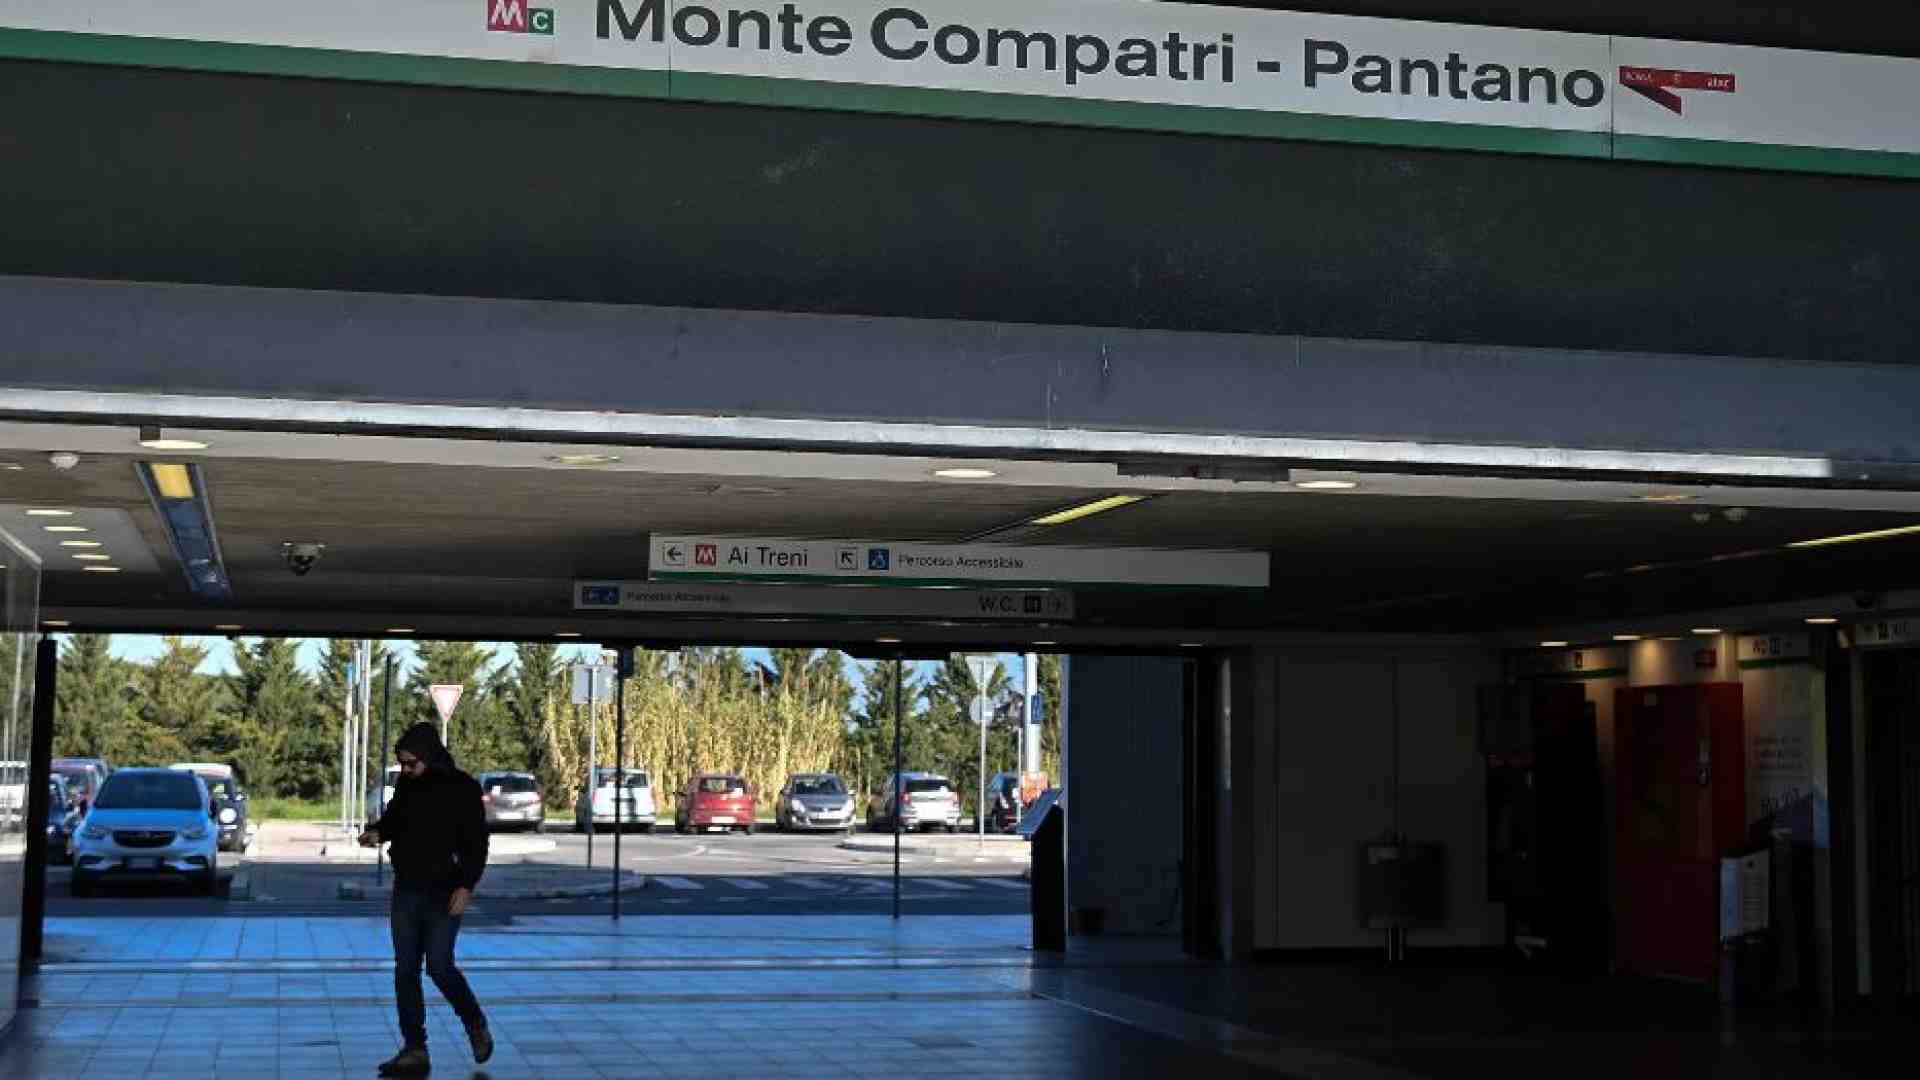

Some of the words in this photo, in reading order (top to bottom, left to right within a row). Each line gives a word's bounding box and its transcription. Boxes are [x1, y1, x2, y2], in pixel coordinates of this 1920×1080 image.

[596, 0, 853, 57] Monte
[870, 7, 1235, 85] Compatri
[1303, 38, 1606, 108] Pantano
[727, 547, 748, 564] Ai
[756, 547, 808, 567] Treni
